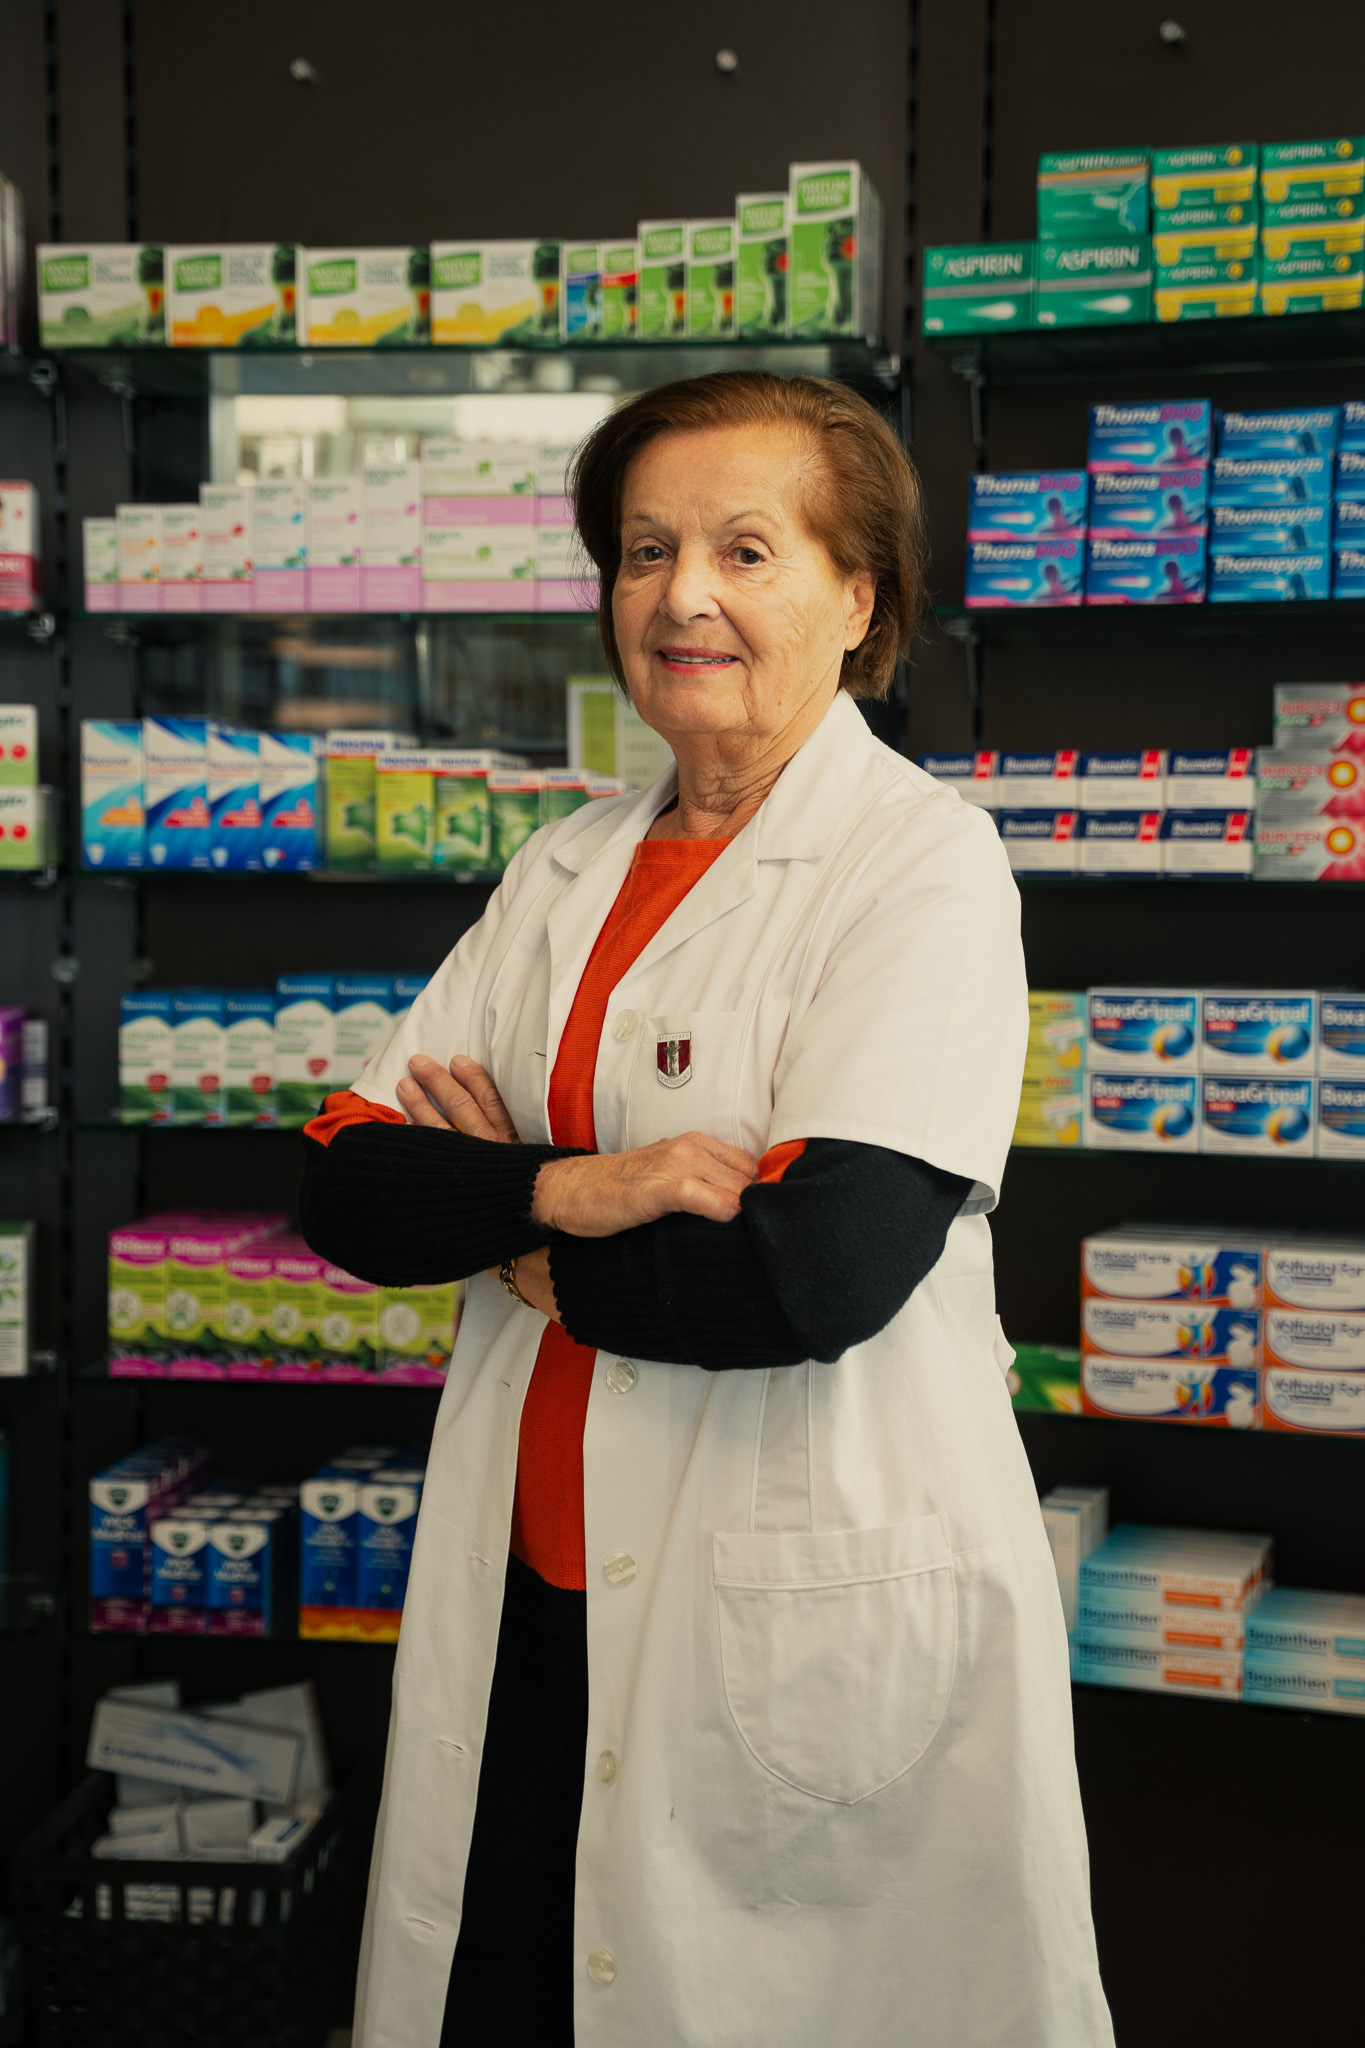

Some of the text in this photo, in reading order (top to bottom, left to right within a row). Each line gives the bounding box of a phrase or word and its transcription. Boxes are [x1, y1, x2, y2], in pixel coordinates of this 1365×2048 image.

[943, 253, 1023, 278] ASPIRIN
[1056, 246, 1140, 271] ASPIRIN
[1222, 411, 1335, 434] Thomapyrin
[1213, 456, 1324, 478] Thomapyrin
[1213, 506, 1324, 526] Thomapyrin
[1213, 555, 1324, 575] Thomapyrin
[1278, 702, 1343, 715] NUROFEN
[1259, 764, 1323, 777] NUROFEN
[1257, 831, 1322, 844] NUROFEN
[1092, 1000, 1193, 1025] BoxaGrippal
[1205, 1002, 1310, 1026] BoxaGrippal
[658, 1033, 690, 1041] APOTHEKER
[1093, 1077, 1193, 1102] BoxaGrippal
[1205, 1081, 1309, 1108] BoxaGrippal
[1271, 1257, 1336, 1277] Voltadol
[1270, 1316, 1335, 1337] Voltadol
[1270, 1375, 1335, 1396] Voltadol
